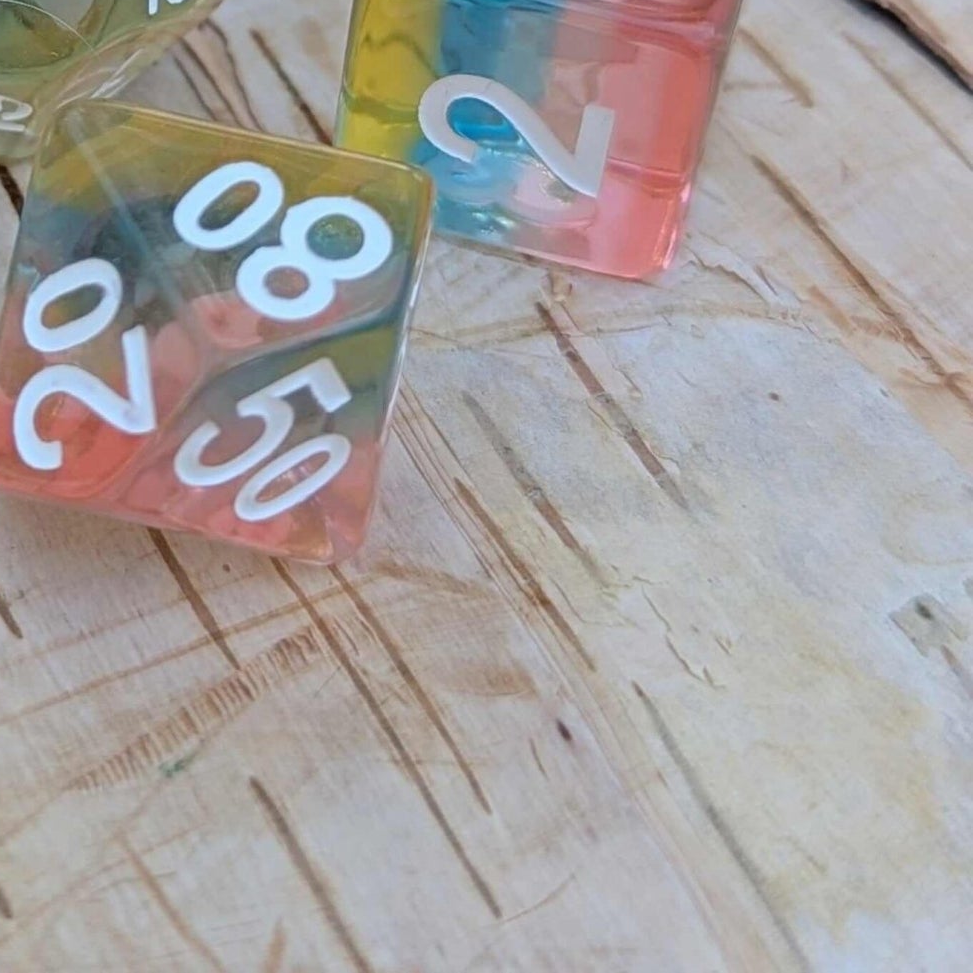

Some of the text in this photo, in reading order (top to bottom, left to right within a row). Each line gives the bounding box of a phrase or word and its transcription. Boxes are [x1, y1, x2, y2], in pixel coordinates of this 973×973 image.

[417, 73, 615, 199] 2
[13, 256, 156, 471] 20
[173, 357, 352, 521] 50
